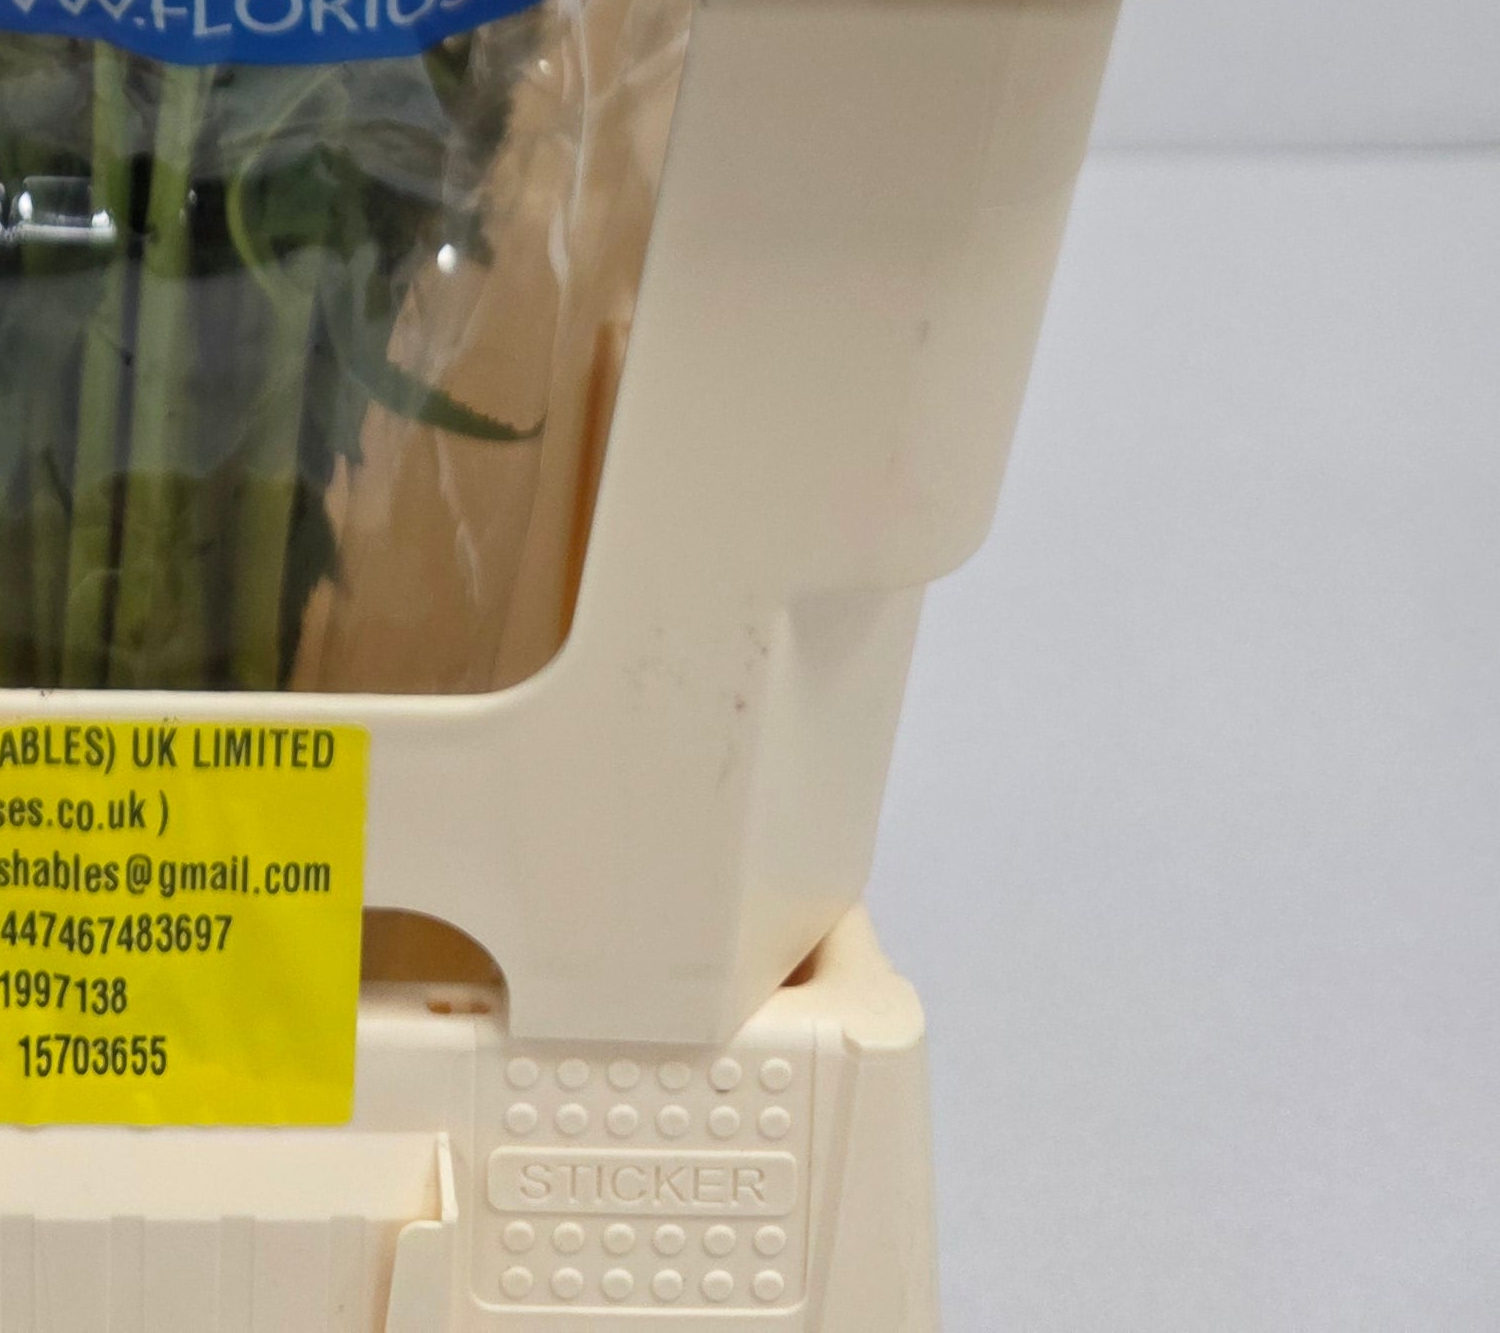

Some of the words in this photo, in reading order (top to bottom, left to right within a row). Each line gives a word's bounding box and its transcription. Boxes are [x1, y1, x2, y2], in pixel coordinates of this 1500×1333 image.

[133, 727, 177, 770] UK
[192, 728, 335, 770] LIMITED
[18, 1035, 167, 1078] 15703655
[518, 1163, 767, 1205] STICKER
